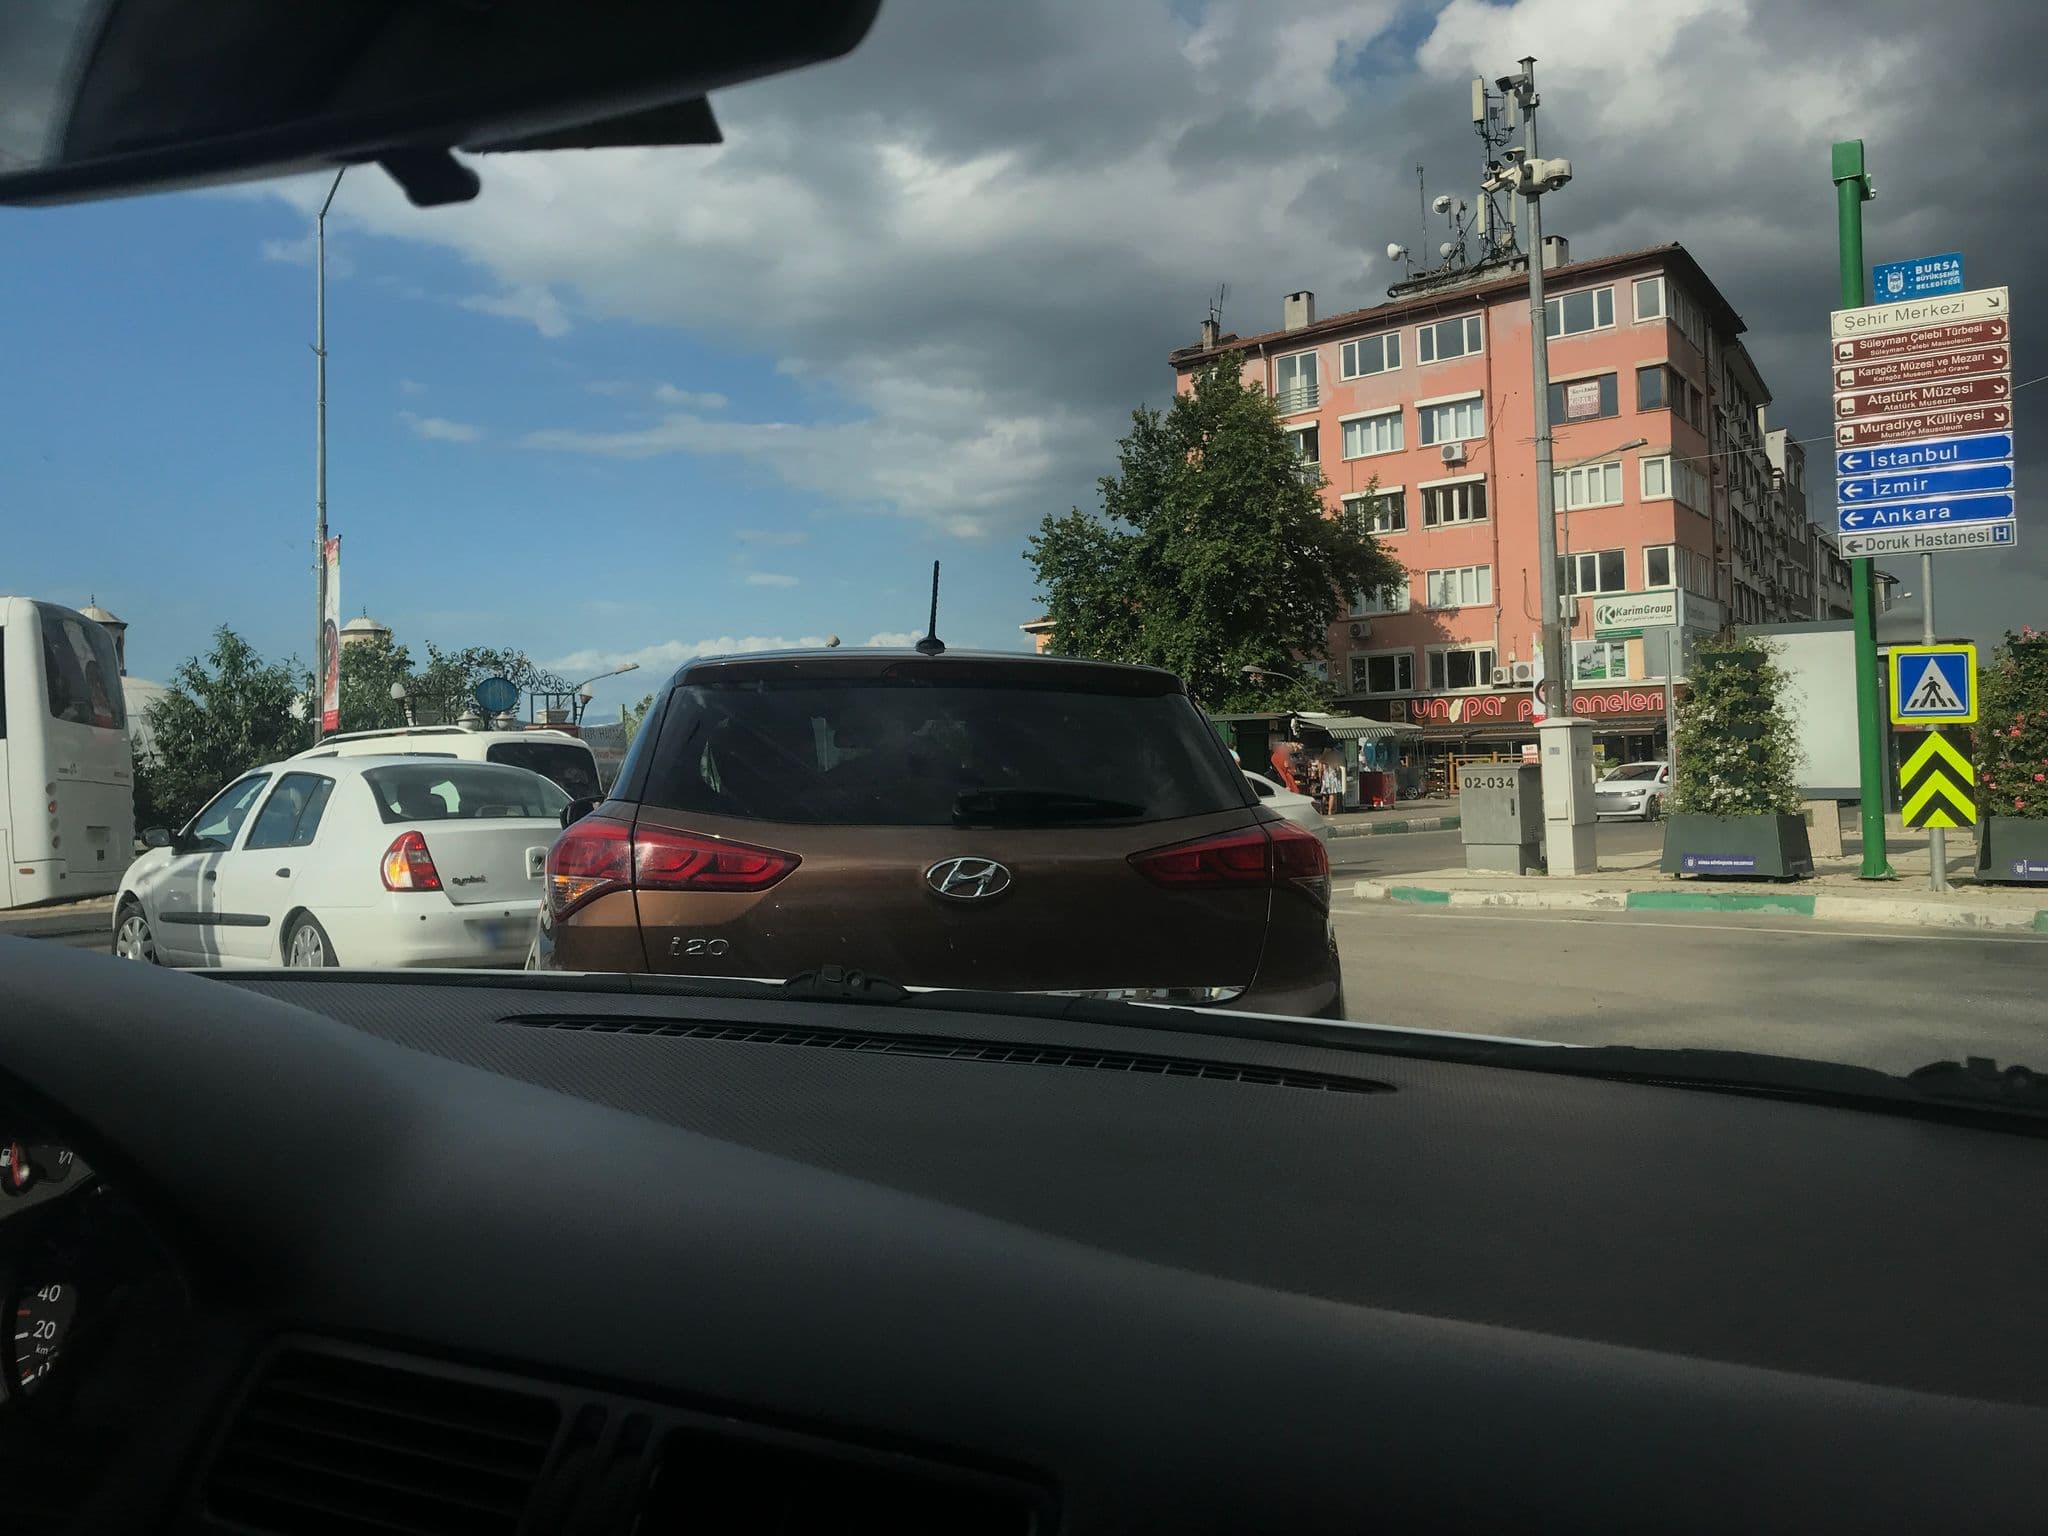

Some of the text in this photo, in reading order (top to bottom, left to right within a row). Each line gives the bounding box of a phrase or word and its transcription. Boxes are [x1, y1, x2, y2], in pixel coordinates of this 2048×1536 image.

[1914, 259, 1960, 275] BURSA
[1844, 300, 1966, 331] Şehir Merkezi
[1859, 325, 1983, 350] Süleyman Çelebi Türbesi
[1870, 337, 1973, 356] Süleyman Çelebi Mausoleum
[1858, 365, 1898, 377] Karagöz
[1900, 359, 1935, 372] Müzesi
[1951, 354, 1985, 364] Mezarı
[1903, 370, 1932, 379] Museum
[1948, 365, 1970, 373] Grave
[1867, 382, 1974, 406] Atatürk Müzesi
[1883, 397, 1957, 412] Atatürk Museum
[1860, 409, 1985, 434] Muradiye Külliyesi
[1881, 424, 1963, 439] Muradiye Mausoleum
[1870, 445, 1958, 468] İstanbul
[1872, 478, 1929, 496] İzmir
[1872, 506, 1951, 525] Ankara
[1866, 528, 2009, 551] Doruk Hastanesi H
[1615, 604, 1673, 618] KarimGroup
[1517, 691, 1663, 722] paneleri
[1463, 776, 1515, 789] 02-034
[671, 936, 730, 956] i20
[57, 1150, 74, 1165] 1/1
[37, 1284, 62, 1302] 40
[32, 1320, 56, 1340] 20
